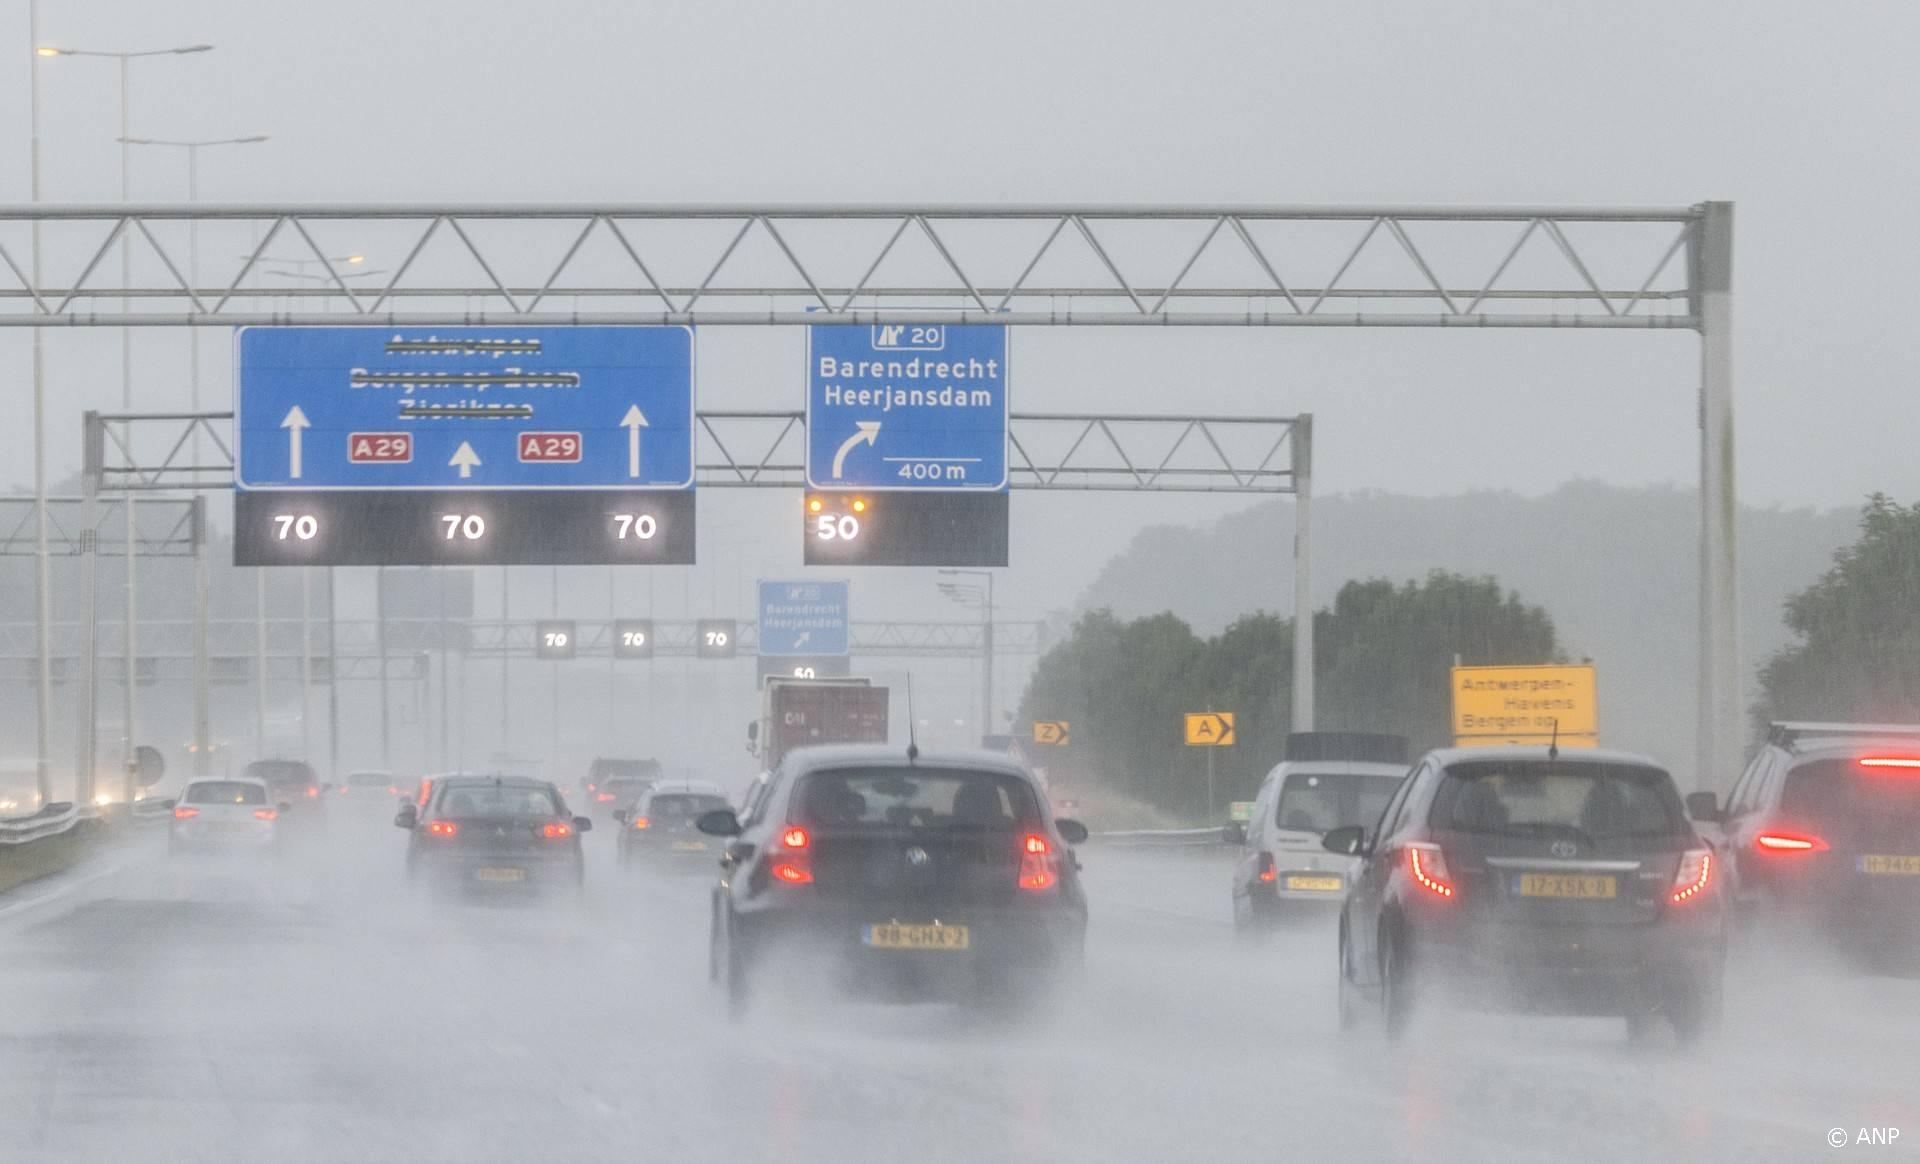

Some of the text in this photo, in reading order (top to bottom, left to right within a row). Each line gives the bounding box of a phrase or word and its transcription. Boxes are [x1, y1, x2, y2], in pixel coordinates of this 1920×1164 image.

[911, 327, 939, 343] 20
[819, 357, 998, 378] Barendrecht
[824, 385, 992, 411] Heerjansdam
[354, 439, 408, 456] A29
[524, 438, 577, 456] A29
[898, 464, 966, 479] 400 m
[274, 515, 318, 539] 70
[442, 515, 485, 539] 70
[614, 514, 657, 539] 70
[817, 516, 859, 540] 50
[766, 604, 841, 614] Barendrecht
[544, 633, 567, 646] 70
[622, 632, 645, 646] 70
[706, 632, 728, 646] 70
[1196, 720, 1213, 737] A
[1462, 714, 1530, 729] Bergen
[1042, 726, 1054, 740] Z
